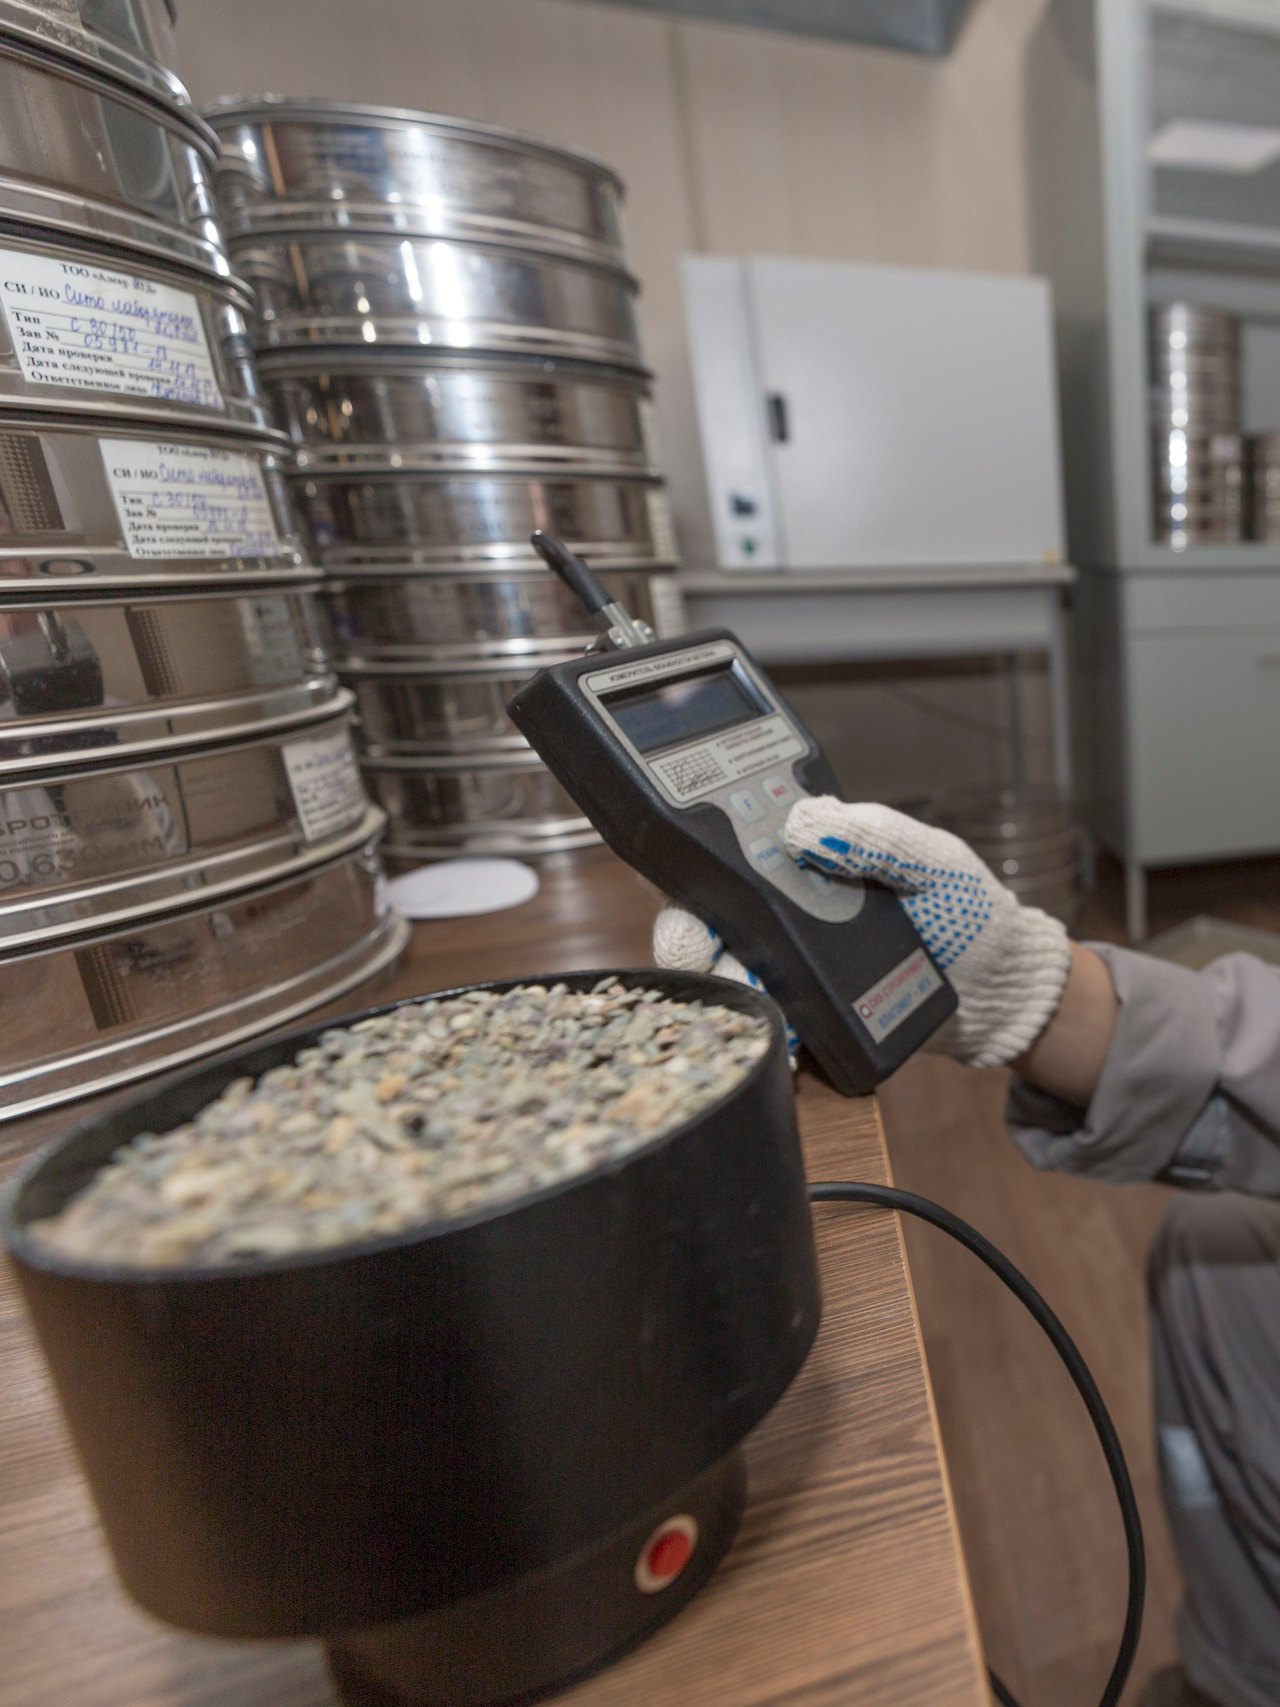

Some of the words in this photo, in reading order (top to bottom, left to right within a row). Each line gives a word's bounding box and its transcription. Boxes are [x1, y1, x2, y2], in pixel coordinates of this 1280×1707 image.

[60, 263, 89, 278] ТОО
[4, 281, 26, 294] СИ
[38, 287, 60, 300] ИО
[12, 311, 41, 325] Тип
[17, 326, 42, 339] Зав
[45, 330, 59, 341] №
[22, 341, 55, 355] Дата
[59, 349, 113, 362] проверки
[27, 356, 59, 369] Дата
[62, 363, 126, 378] следующей
[31, 371, 121, 390] Ответственное
[113, 468, 132, 479] СИ
